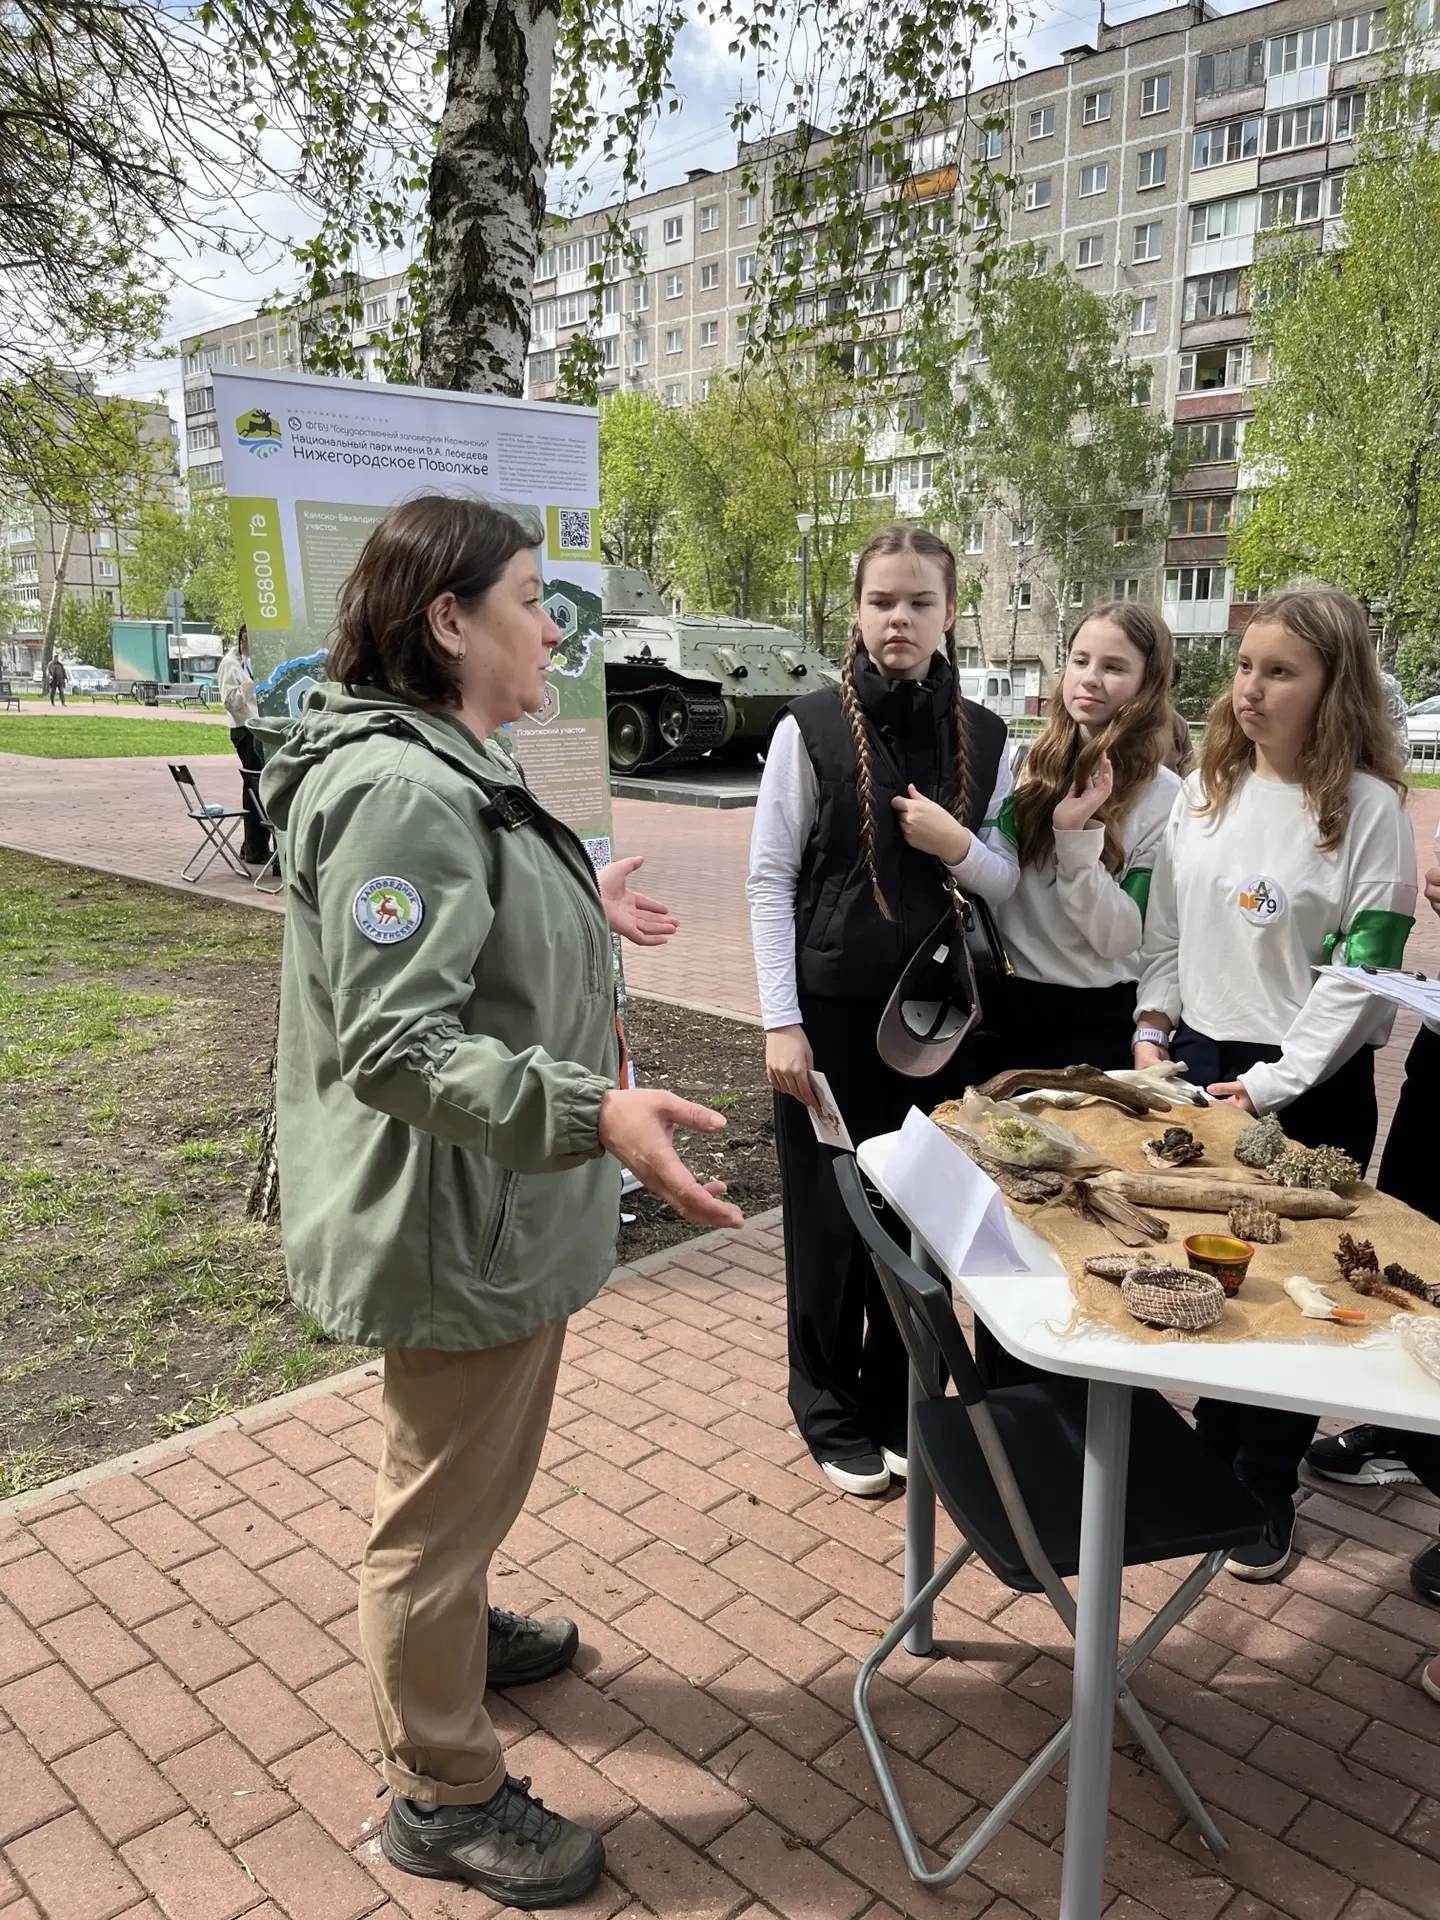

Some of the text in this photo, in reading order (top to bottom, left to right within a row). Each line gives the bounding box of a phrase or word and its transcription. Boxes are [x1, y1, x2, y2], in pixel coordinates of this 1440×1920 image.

[305, 421, 329, 432] ФГБУ
[291, 433, 368, 450] Национальный
[369, 443, 392, 453] парк
[394, 444, 425, 455] имени
[444, 448, 488, 460] Лебедева
[293, 445, 490, 475] Нижегородское Поволжье
[304, 523, 338, 532] участок
[248, 513, 278, 618] 65800 га
[516, 727, 587, 737] Поволжский участок
[360, 880, 416, 903] ЗАПОВЕДНИК
[1255, 897, 1277, 914] 79
[362, 919, 415, 939] КЕРЖЕНСКИЙ
